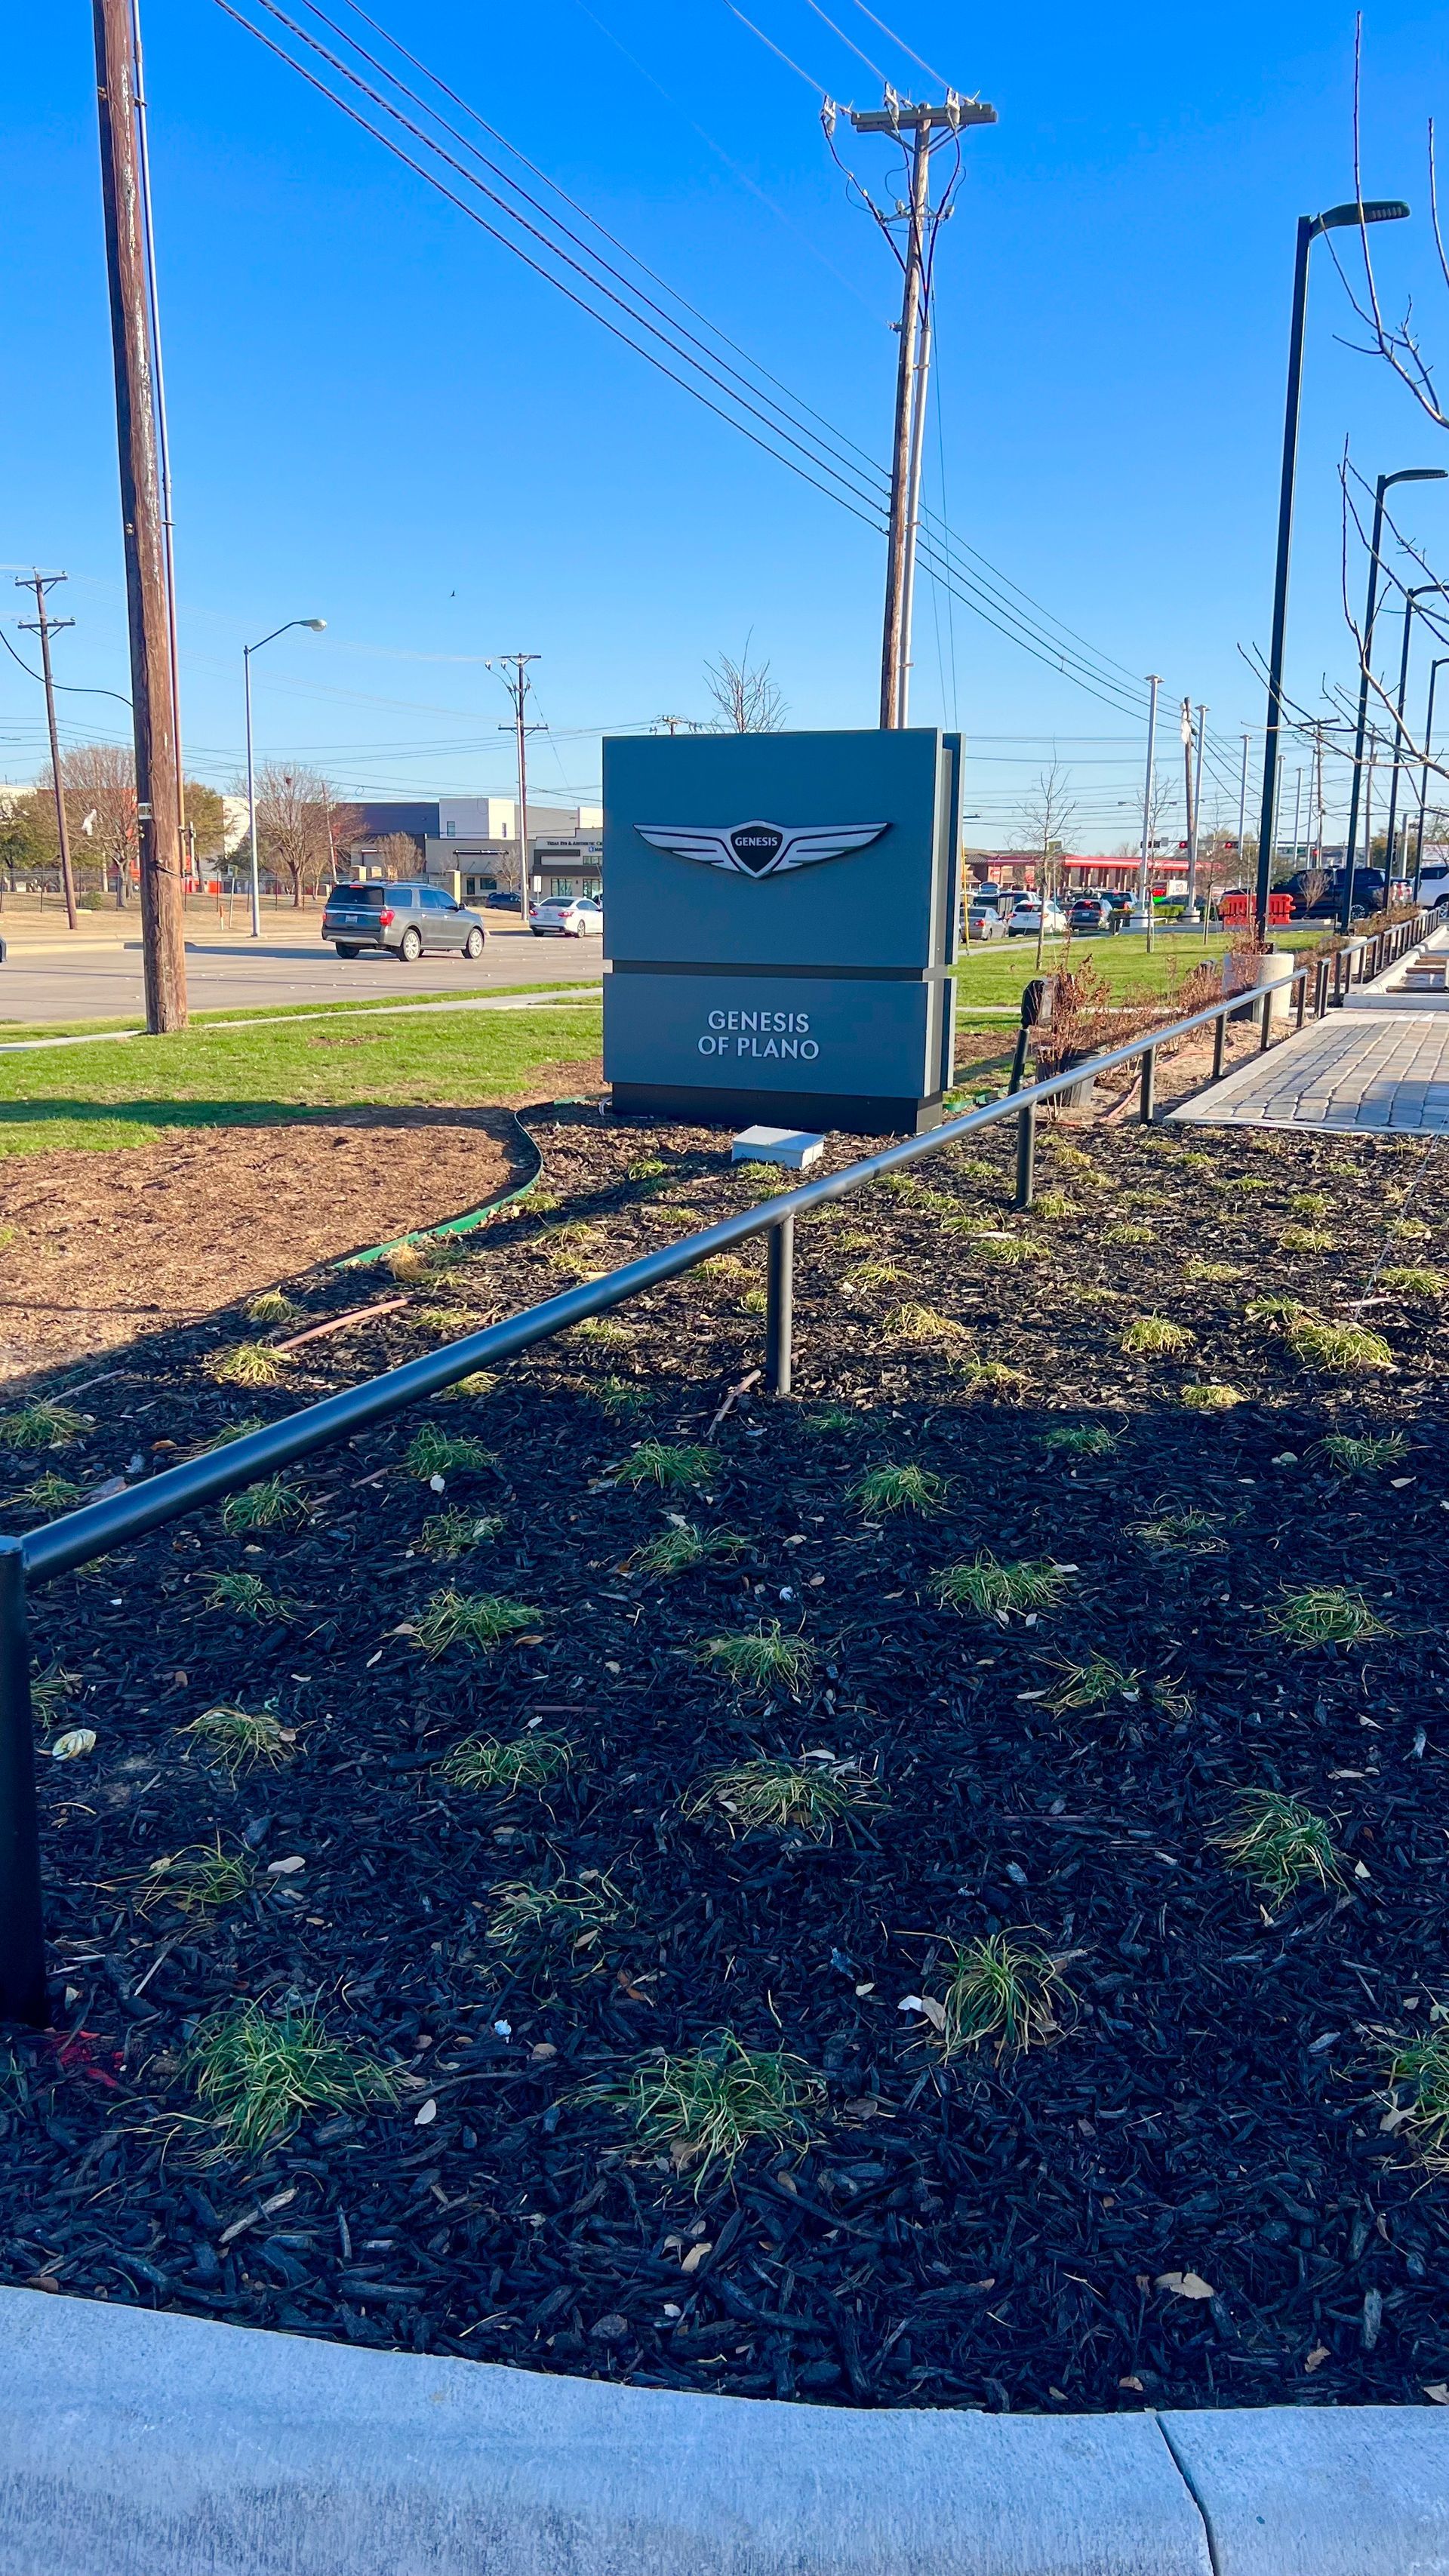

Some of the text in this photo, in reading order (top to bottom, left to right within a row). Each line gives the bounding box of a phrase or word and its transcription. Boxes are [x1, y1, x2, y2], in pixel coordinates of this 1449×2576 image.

[734, 836, 778, 847] GENESIS
[708, 1010, 810, 1033] GENESIS
[697, 1036, 820, 1060] OF PLANO
